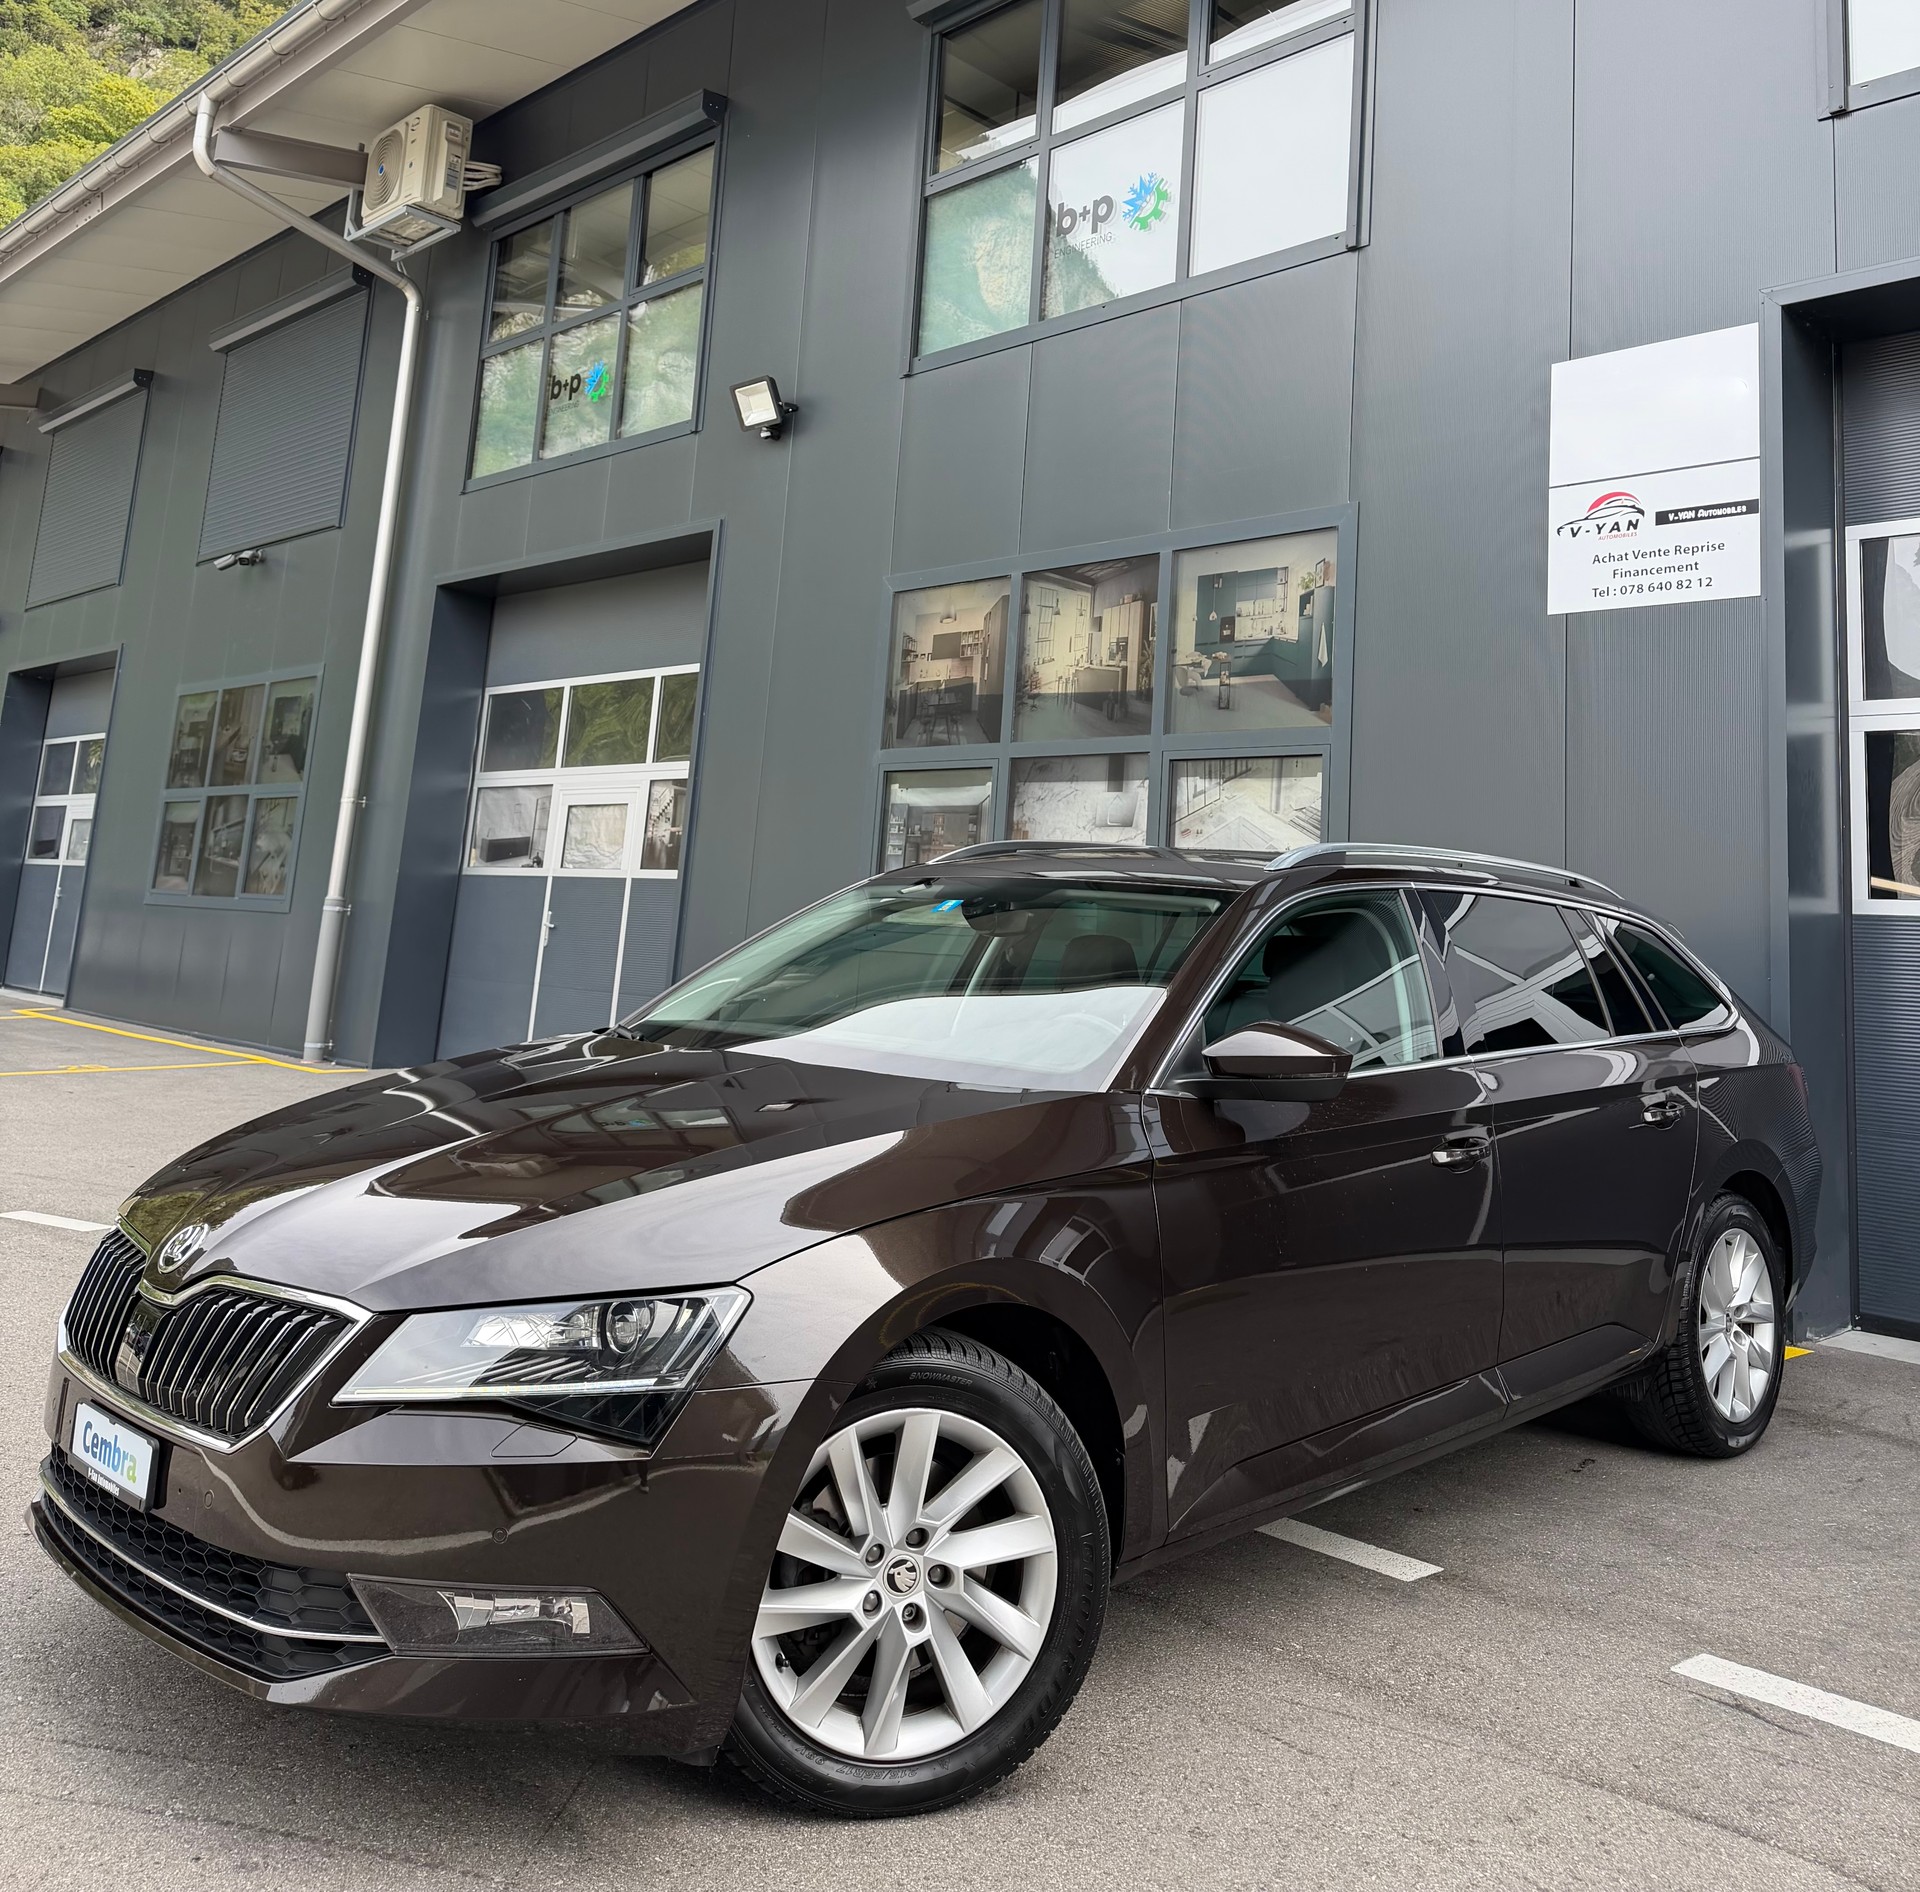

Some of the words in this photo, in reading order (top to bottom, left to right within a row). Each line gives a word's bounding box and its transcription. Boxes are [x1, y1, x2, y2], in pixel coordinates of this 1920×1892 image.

[1056, 195, 1114, 237] b+p
[1054, 232, 1113, 259] ENGINEERING
[550, 374, 582, 401] b+p
[1668, 510, 1695, 521] V-YAN
[1570, 518, 1640, 538] V-YAN
[1598, 532, 1637, 541] AUTOMOBILES
[1592, 552, 1629, 565] Achat
[1632, 549, 1670, 560] Vente
[1674, 541, 1725, 556] Reprise
[1612, 561, 1699, 579] Financement
[1620, 583, 1644, 595] 078
[1648, 581, 1672, 593] 640
[1676, 578, 1692, 590] 82
[1697, 576, 1713, 588] 12
[909, 1372, 973, 1386] SNOWMASTER
[83, 1421, 137, 1484] Cembra
